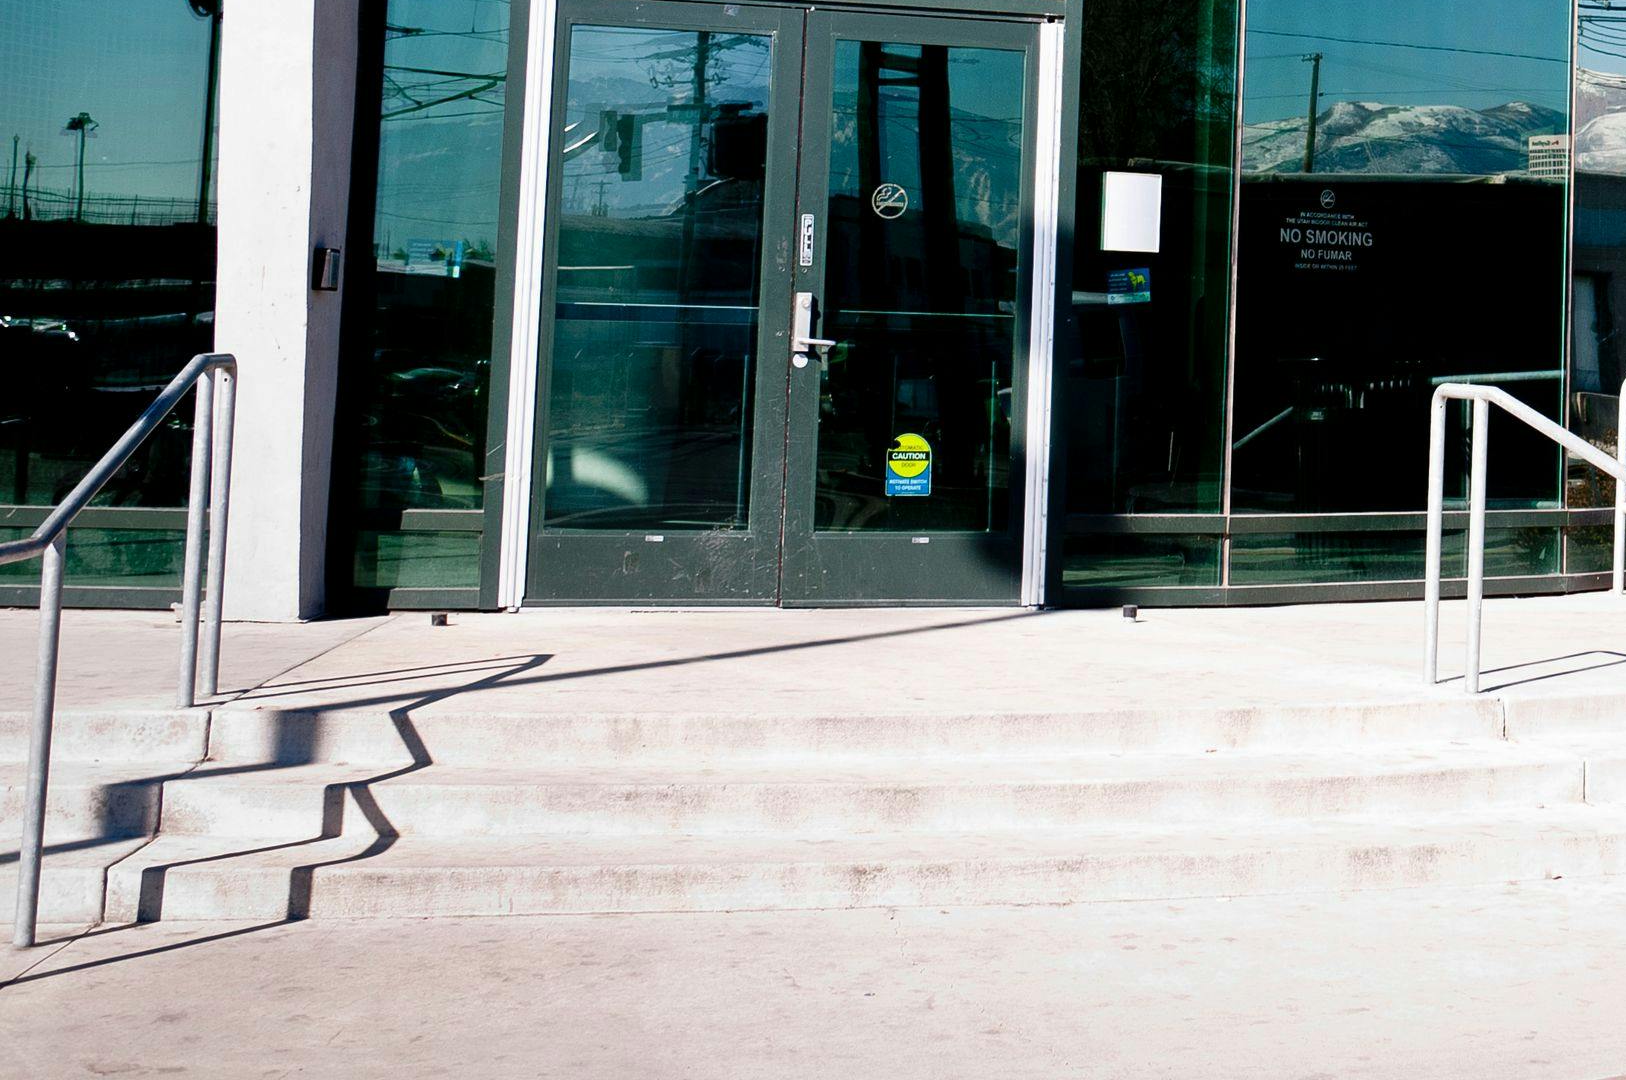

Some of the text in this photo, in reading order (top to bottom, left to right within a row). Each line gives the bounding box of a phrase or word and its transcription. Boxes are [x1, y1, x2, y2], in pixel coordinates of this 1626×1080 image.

[1280, 228, 1373, 247] NO SMOKING
[1301, 249, 1352, 261] NO FUMAR
[892, 452, 926, 460] CAUTION
